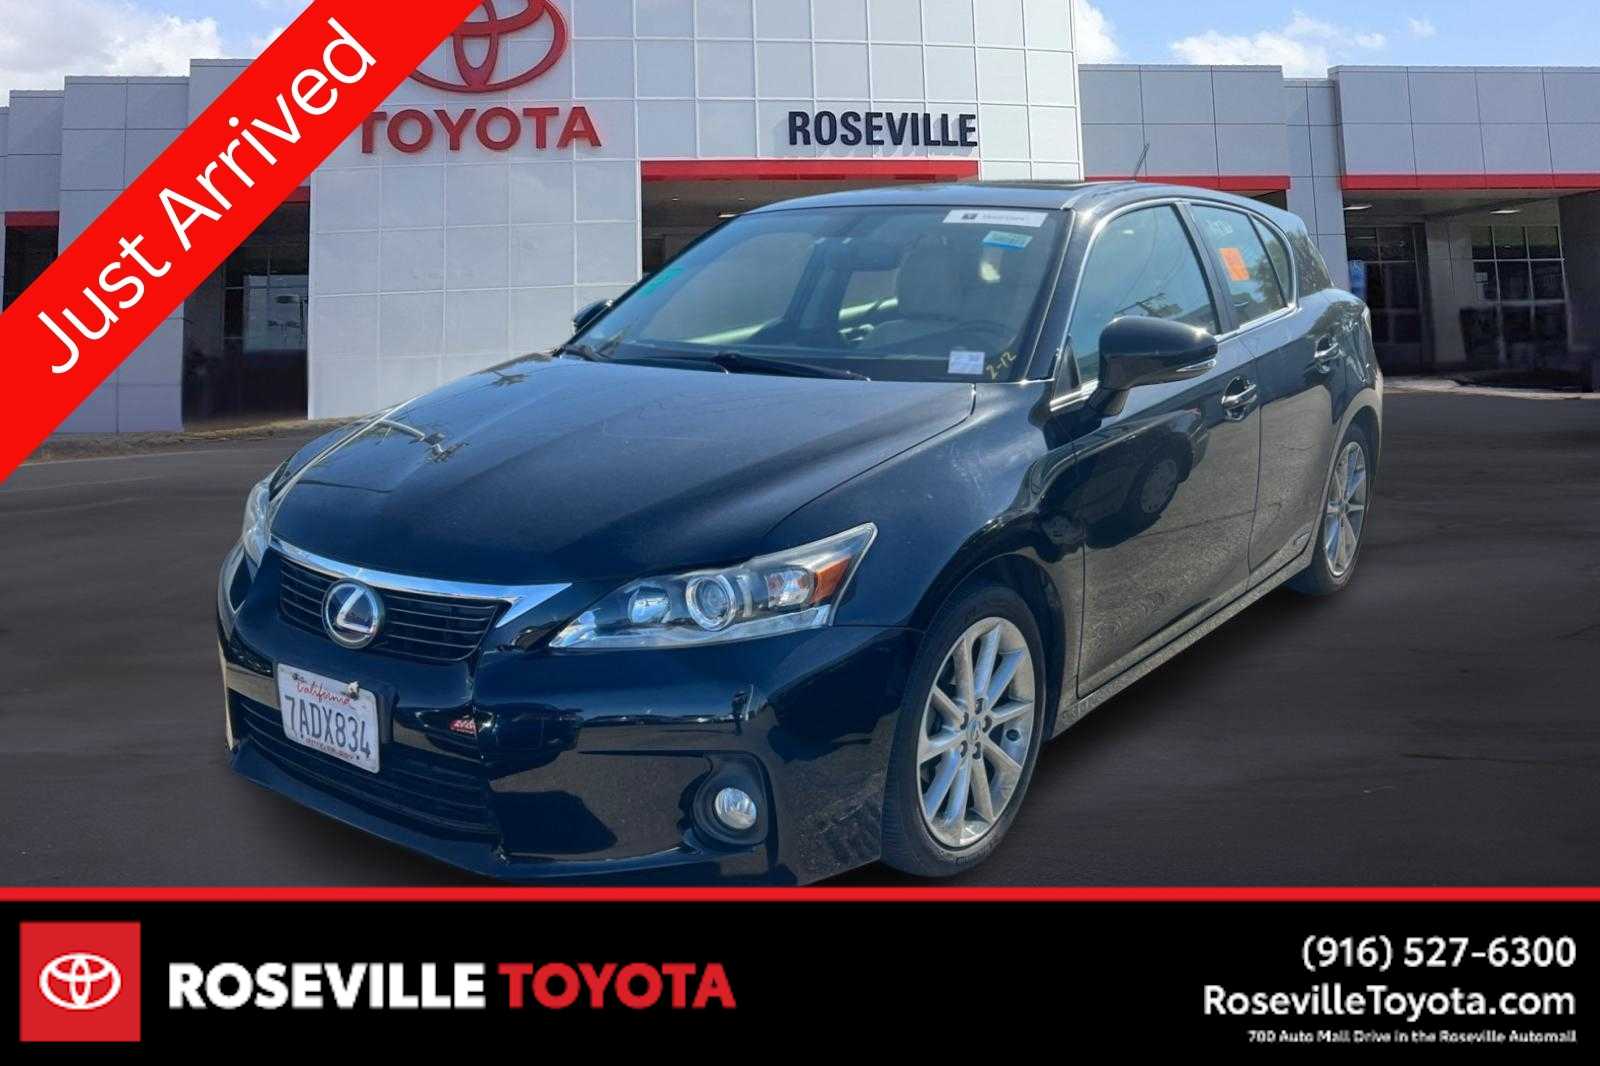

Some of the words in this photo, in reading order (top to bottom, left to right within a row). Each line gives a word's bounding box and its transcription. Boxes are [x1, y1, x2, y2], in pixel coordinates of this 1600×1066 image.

[361, 106, 602, 154] TOYOTA
[788, 110, 978, 147] ROSEVILLE
[284, 695, 371, 758] 7ADX834
